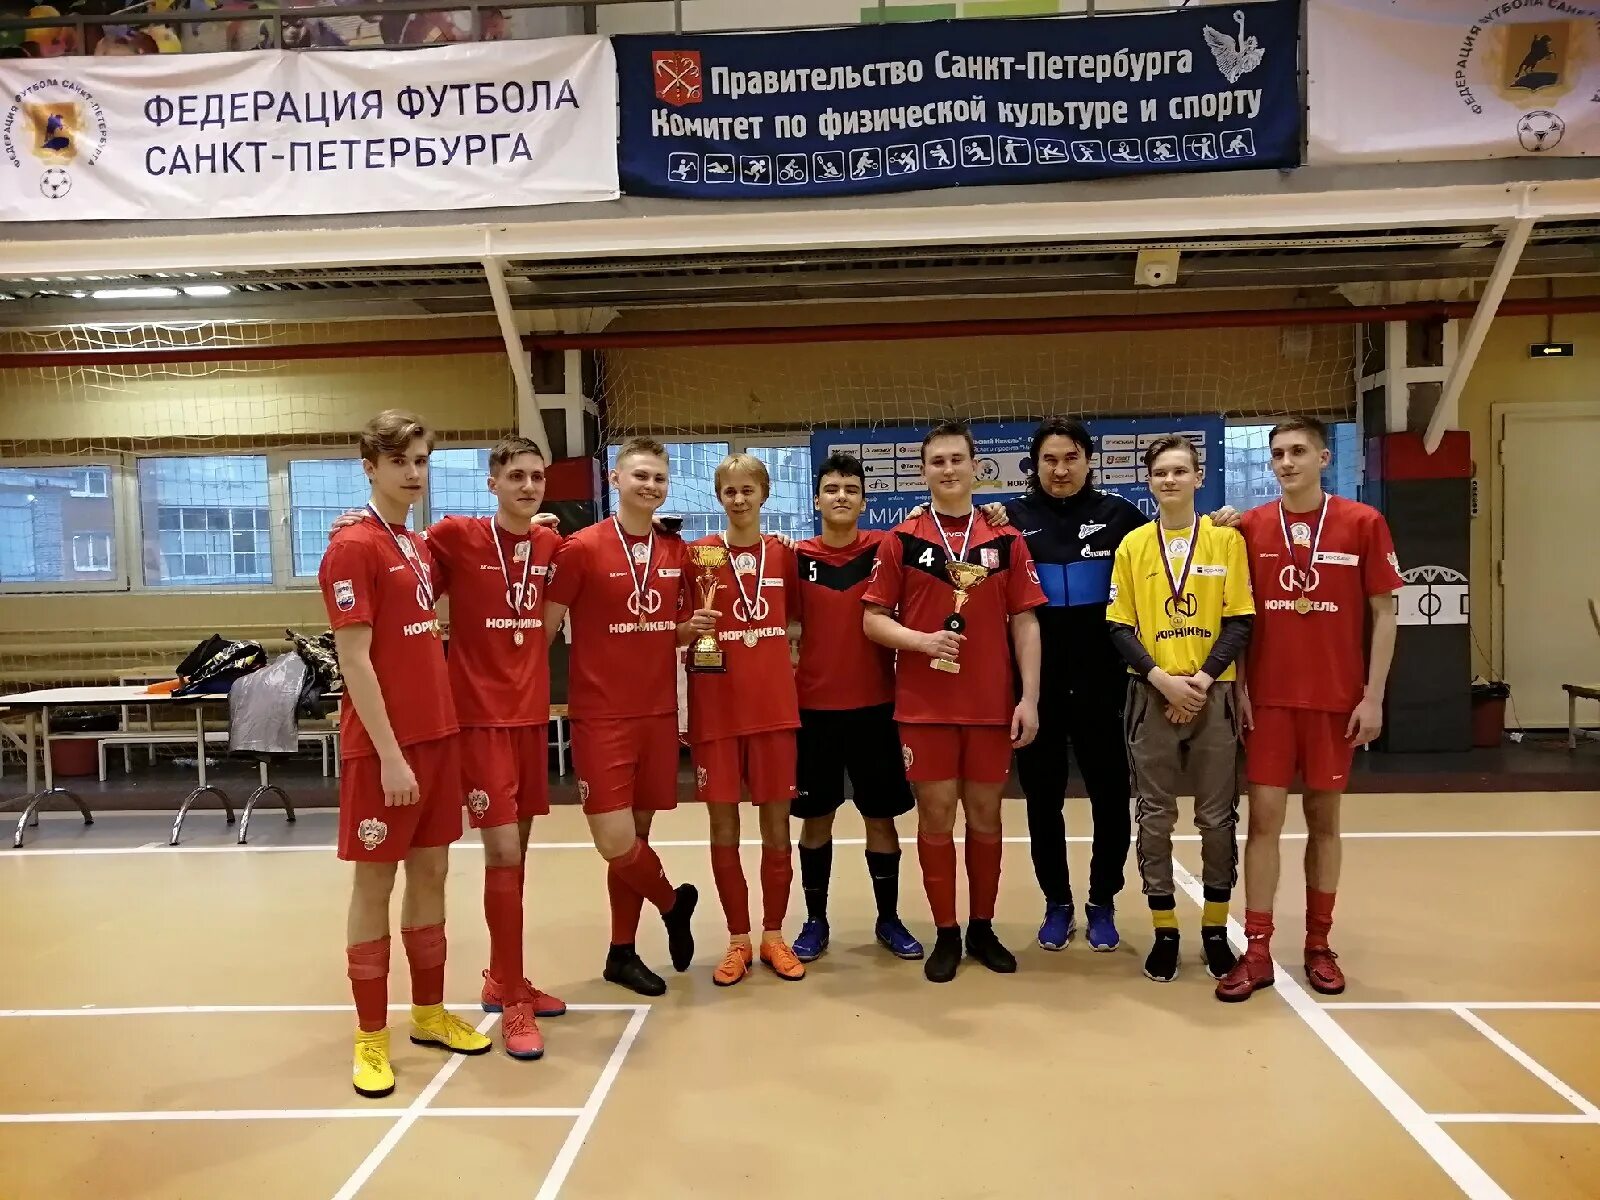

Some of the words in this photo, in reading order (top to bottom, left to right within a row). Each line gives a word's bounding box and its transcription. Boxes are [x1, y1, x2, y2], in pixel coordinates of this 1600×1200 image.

[710, 59, 923, 100] Правительство
[934, 48, 1193, 84] Санкт-Петербурга
[1455, 25, 1482, 114] ФЕДЕРАЦИЯ
[143, 89, 384, 131] ФЕДЕРАЦИЯ
[396, 79, 580, 120] ФУТБОЛА
[651, 108, 764, 141] Комитет
[774, 114, 807, 138] по
[818, 95, 986, 141] физической
[998, 99, 1128, 130] культуре
[1140, 98, 1157, 122] и
[1169, 89, 1262, 120] спорту
[144, 132, 534, 176] САНКТ-ПЕТЕРБУРГА
[808, 561, 818, 582] 5
[918, 547, 935, 567] 4
[1264, 599, 1339, 612] НОРНКЕЛЬ
